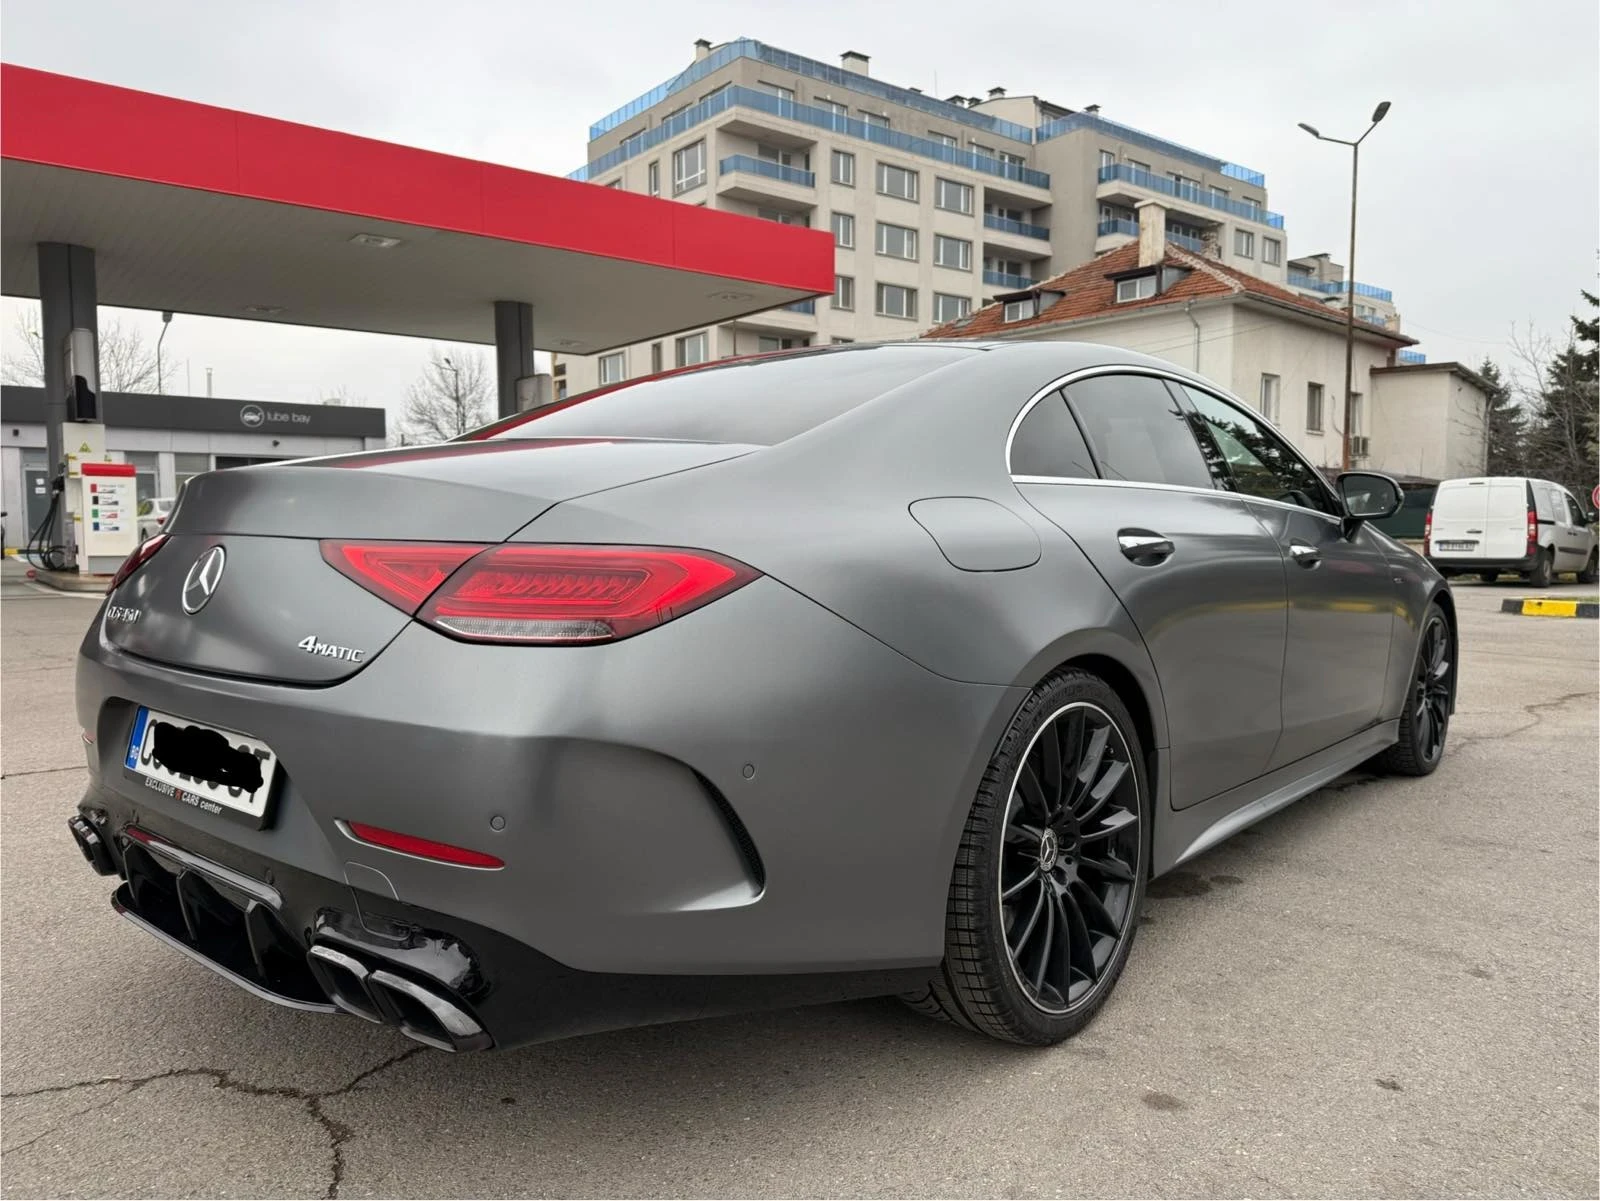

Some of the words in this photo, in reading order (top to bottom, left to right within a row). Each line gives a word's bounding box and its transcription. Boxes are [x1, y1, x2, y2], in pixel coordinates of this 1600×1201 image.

[266, 411, 290, 422] lube
[291, 411, 312, 424] bay
[298, 635, 365, 662] 4MATIC
[144, 776, 176, 798] EXCLUSIVE
[181, 791, 200, 807] CARS
[200, 801, 223, 815] center
